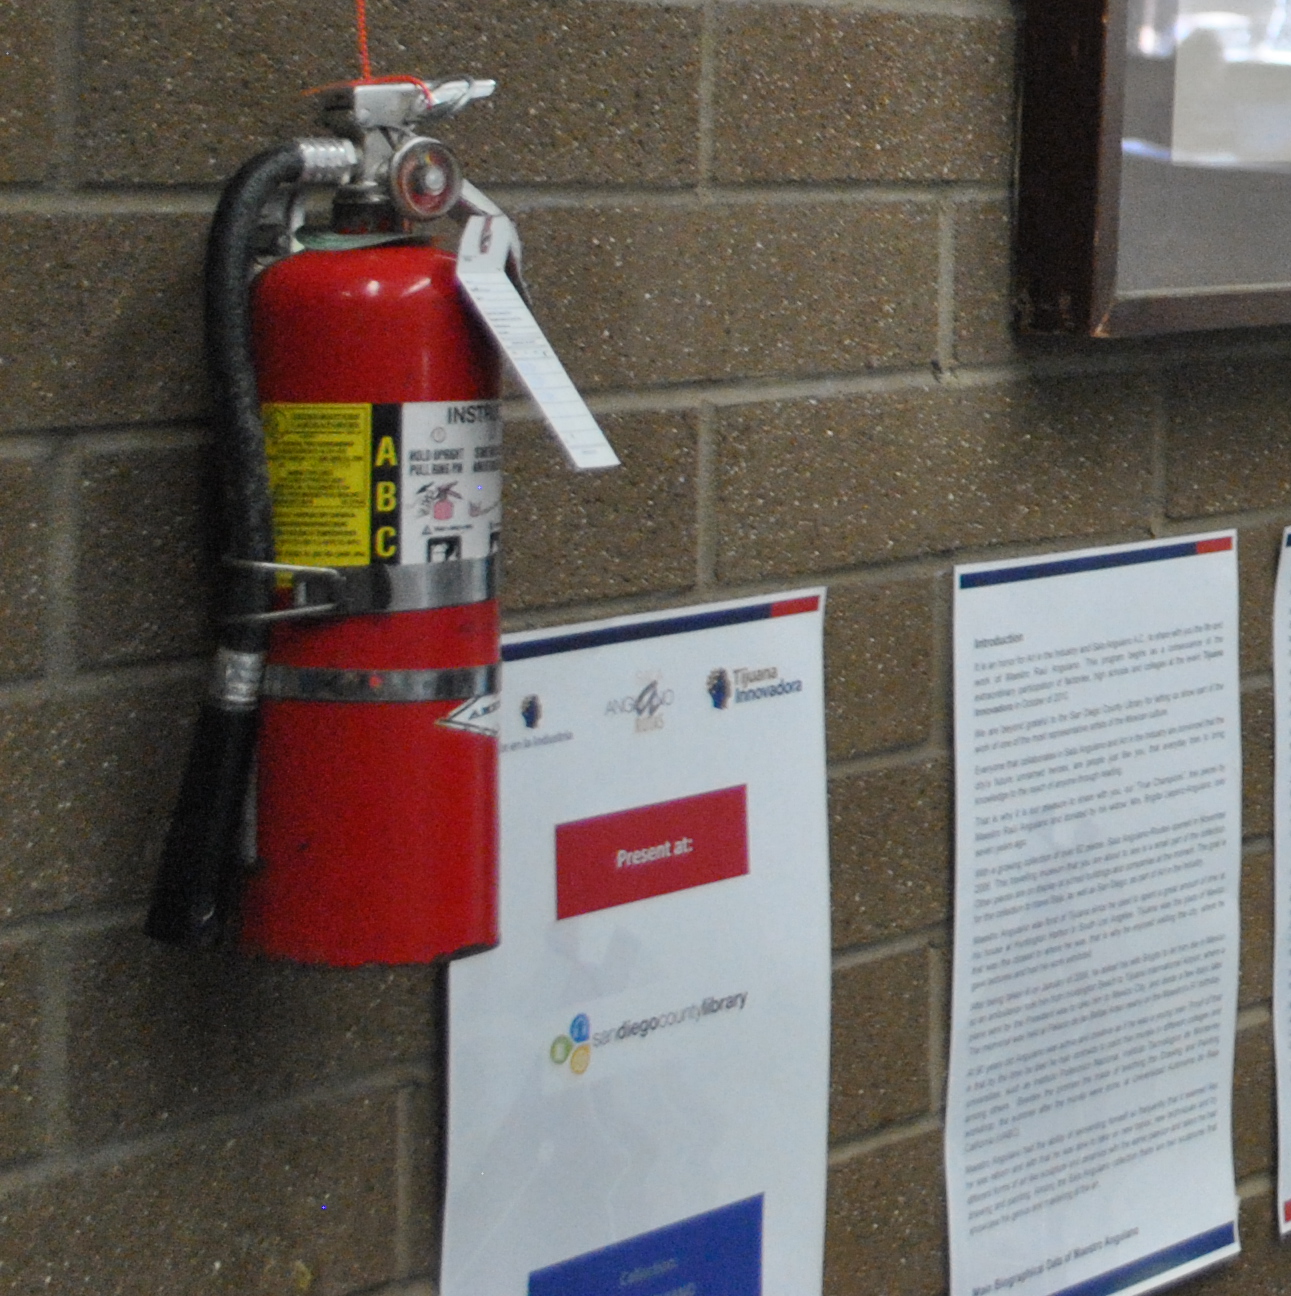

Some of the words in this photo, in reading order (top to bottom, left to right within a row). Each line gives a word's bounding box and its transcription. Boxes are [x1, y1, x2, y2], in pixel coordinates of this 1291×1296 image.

[375, 436, 397, 466] A
[376, 481, 397, 512] B
[375, 526, 397, 557] C
[733, 666, 778, 689] Tijuana
[735, 678, 803, 704] Innovadora
[616, 840, 671, 868] Present
[673, 836, 694, 855] at:
